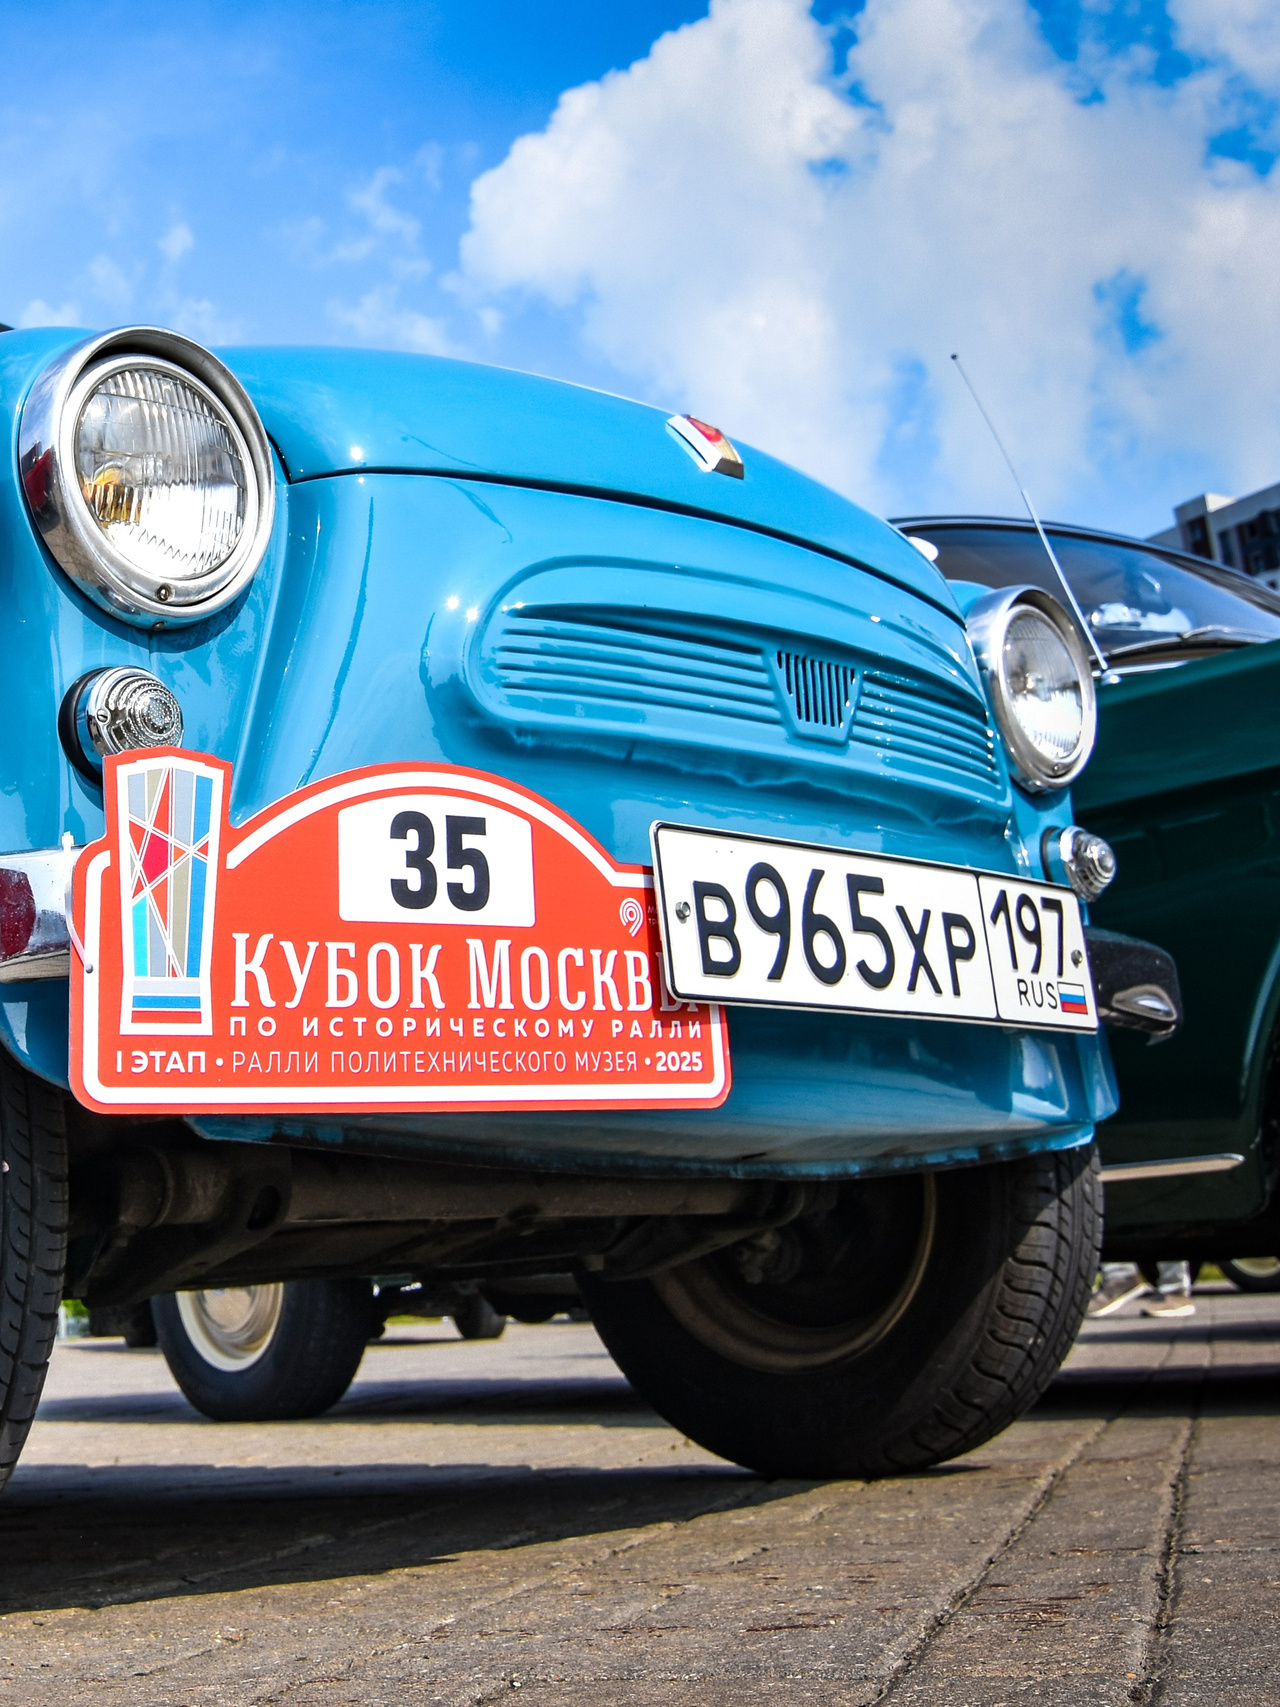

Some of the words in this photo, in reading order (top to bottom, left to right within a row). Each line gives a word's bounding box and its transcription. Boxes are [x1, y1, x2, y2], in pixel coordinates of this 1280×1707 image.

[390, 811, 490, 912] 35
[991, 889, 1064, 977] 197
[230, 932, 446, 1010] КУБОК
[1017, 979, 1058, 1009] RUS
[229, 1016, 277, 1037] ПО
[302, 1016, 594, 1039] ИСТОРИЧЕСКОМУ
[611, 1019, 702, 1039] РАЛЛИ
[130, 1050, 206, 1074] ЭТАП
[232, 1050, 318, 1074] РАЛЛИ
[331, 1050, 567, 1073] ПОЛИТЕХНИЧЕСКОГО
[575, 1050, 638, 1073] МУЗЕЯ
[655, 1050, 704, 1073] 2025
